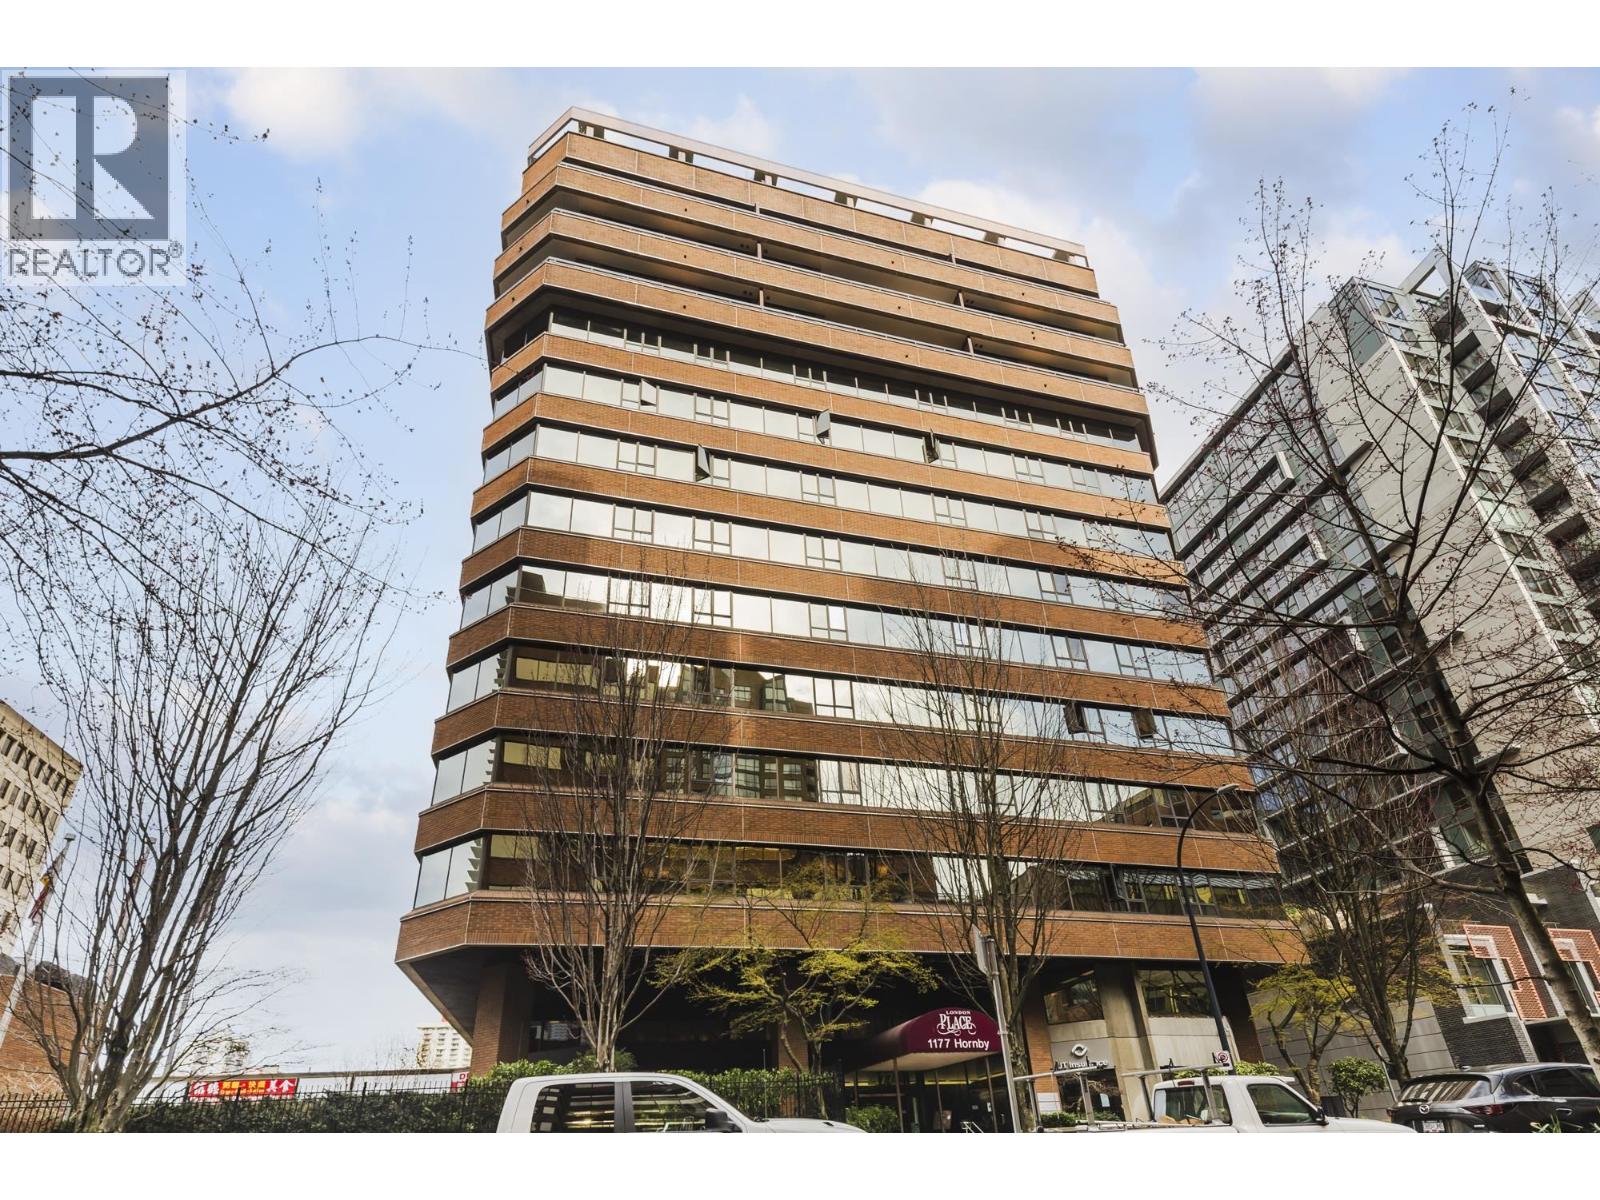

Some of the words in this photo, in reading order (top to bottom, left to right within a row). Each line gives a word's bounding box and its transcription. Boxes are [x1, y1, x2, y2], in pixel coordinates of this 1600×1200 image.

[937, 1013, 976, 1034] PLACE
[927, 1038, 951, 1049] 1177
[954, 1038, 990, 1051] Hornby
[1069, 1059, 1108, 1069] Insuce
